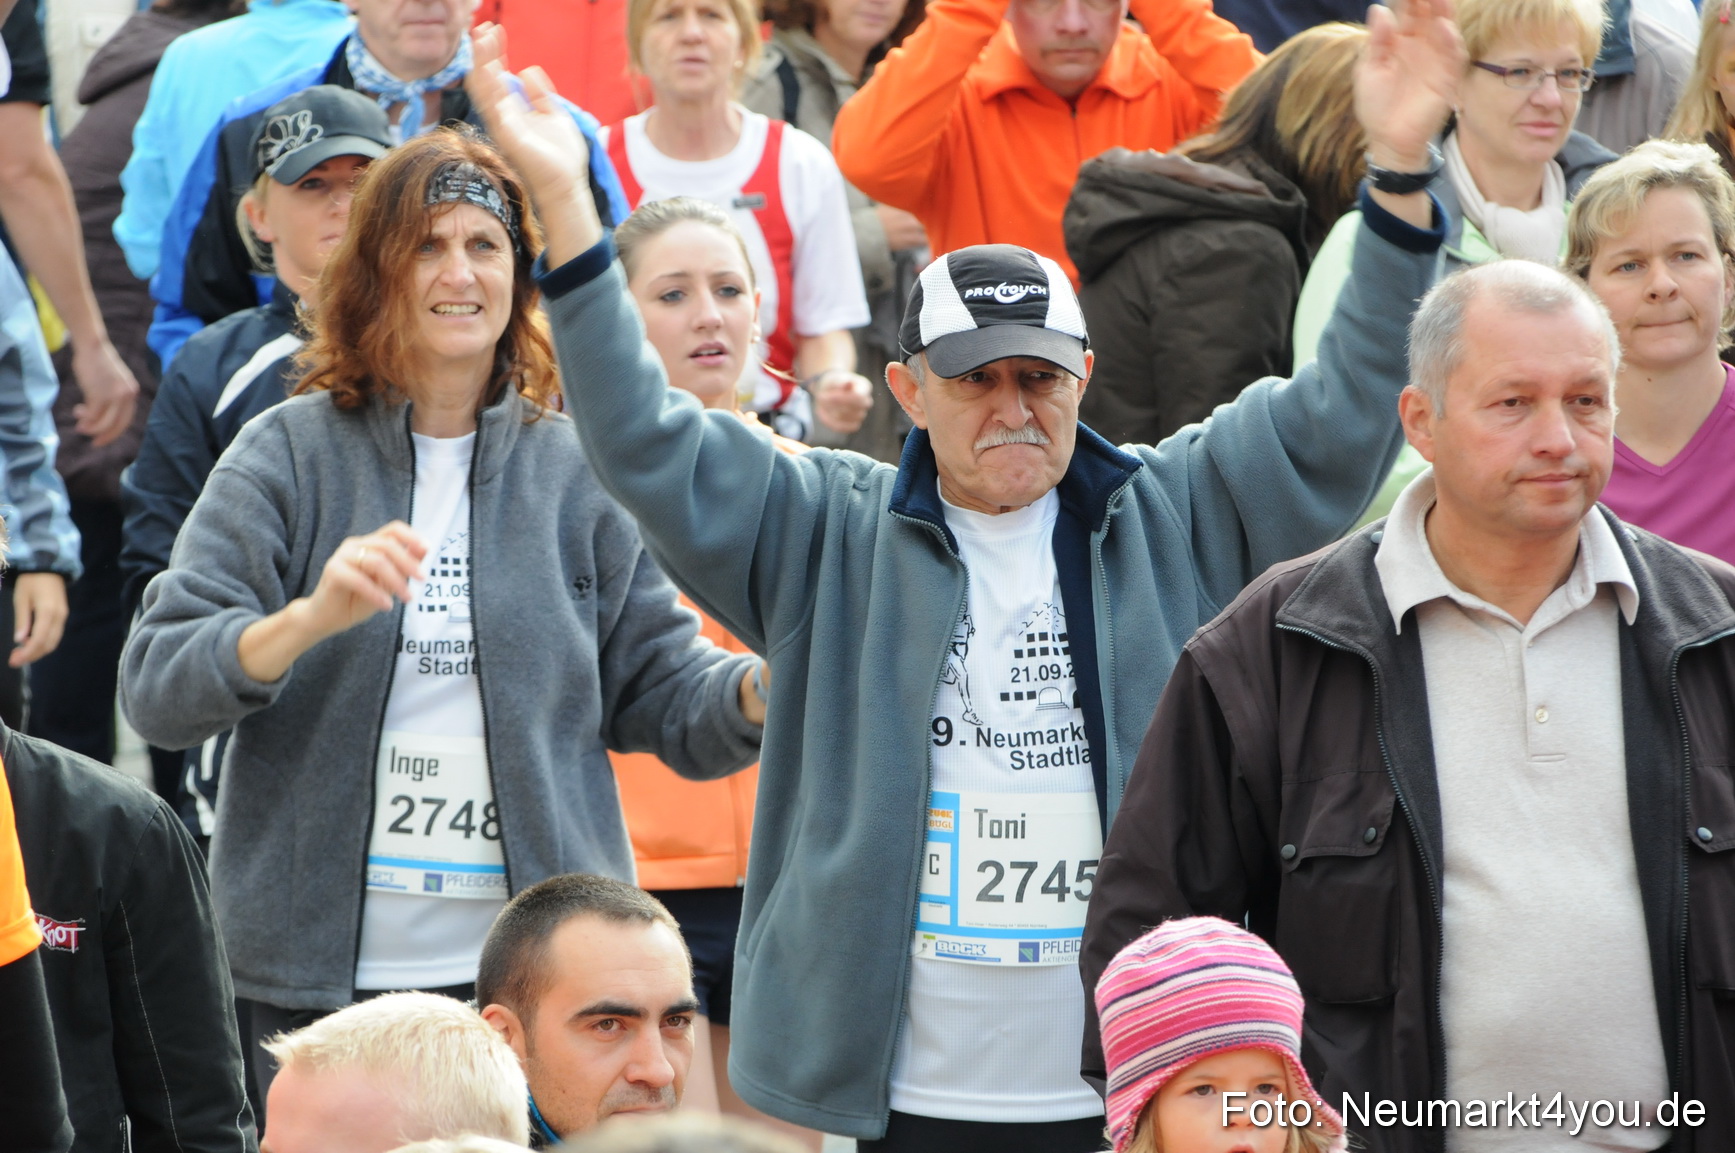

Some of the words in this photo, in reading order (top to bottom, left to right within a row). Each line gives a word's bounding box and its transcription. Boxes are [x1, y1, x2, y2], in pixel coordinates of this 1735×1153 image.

[401, 635, 476, 655] eumar
[389, 746, 439, 781] Inge
[1010, 745, 1091, 770] Stadtla
[387, 794, 502, 841] 2748
[974, 808, 1026, 839] Toni
[929, 853, 940, 875] C
[975, 860, 1099, 903] 2745
[935, 941, 986, 955] BOCK
